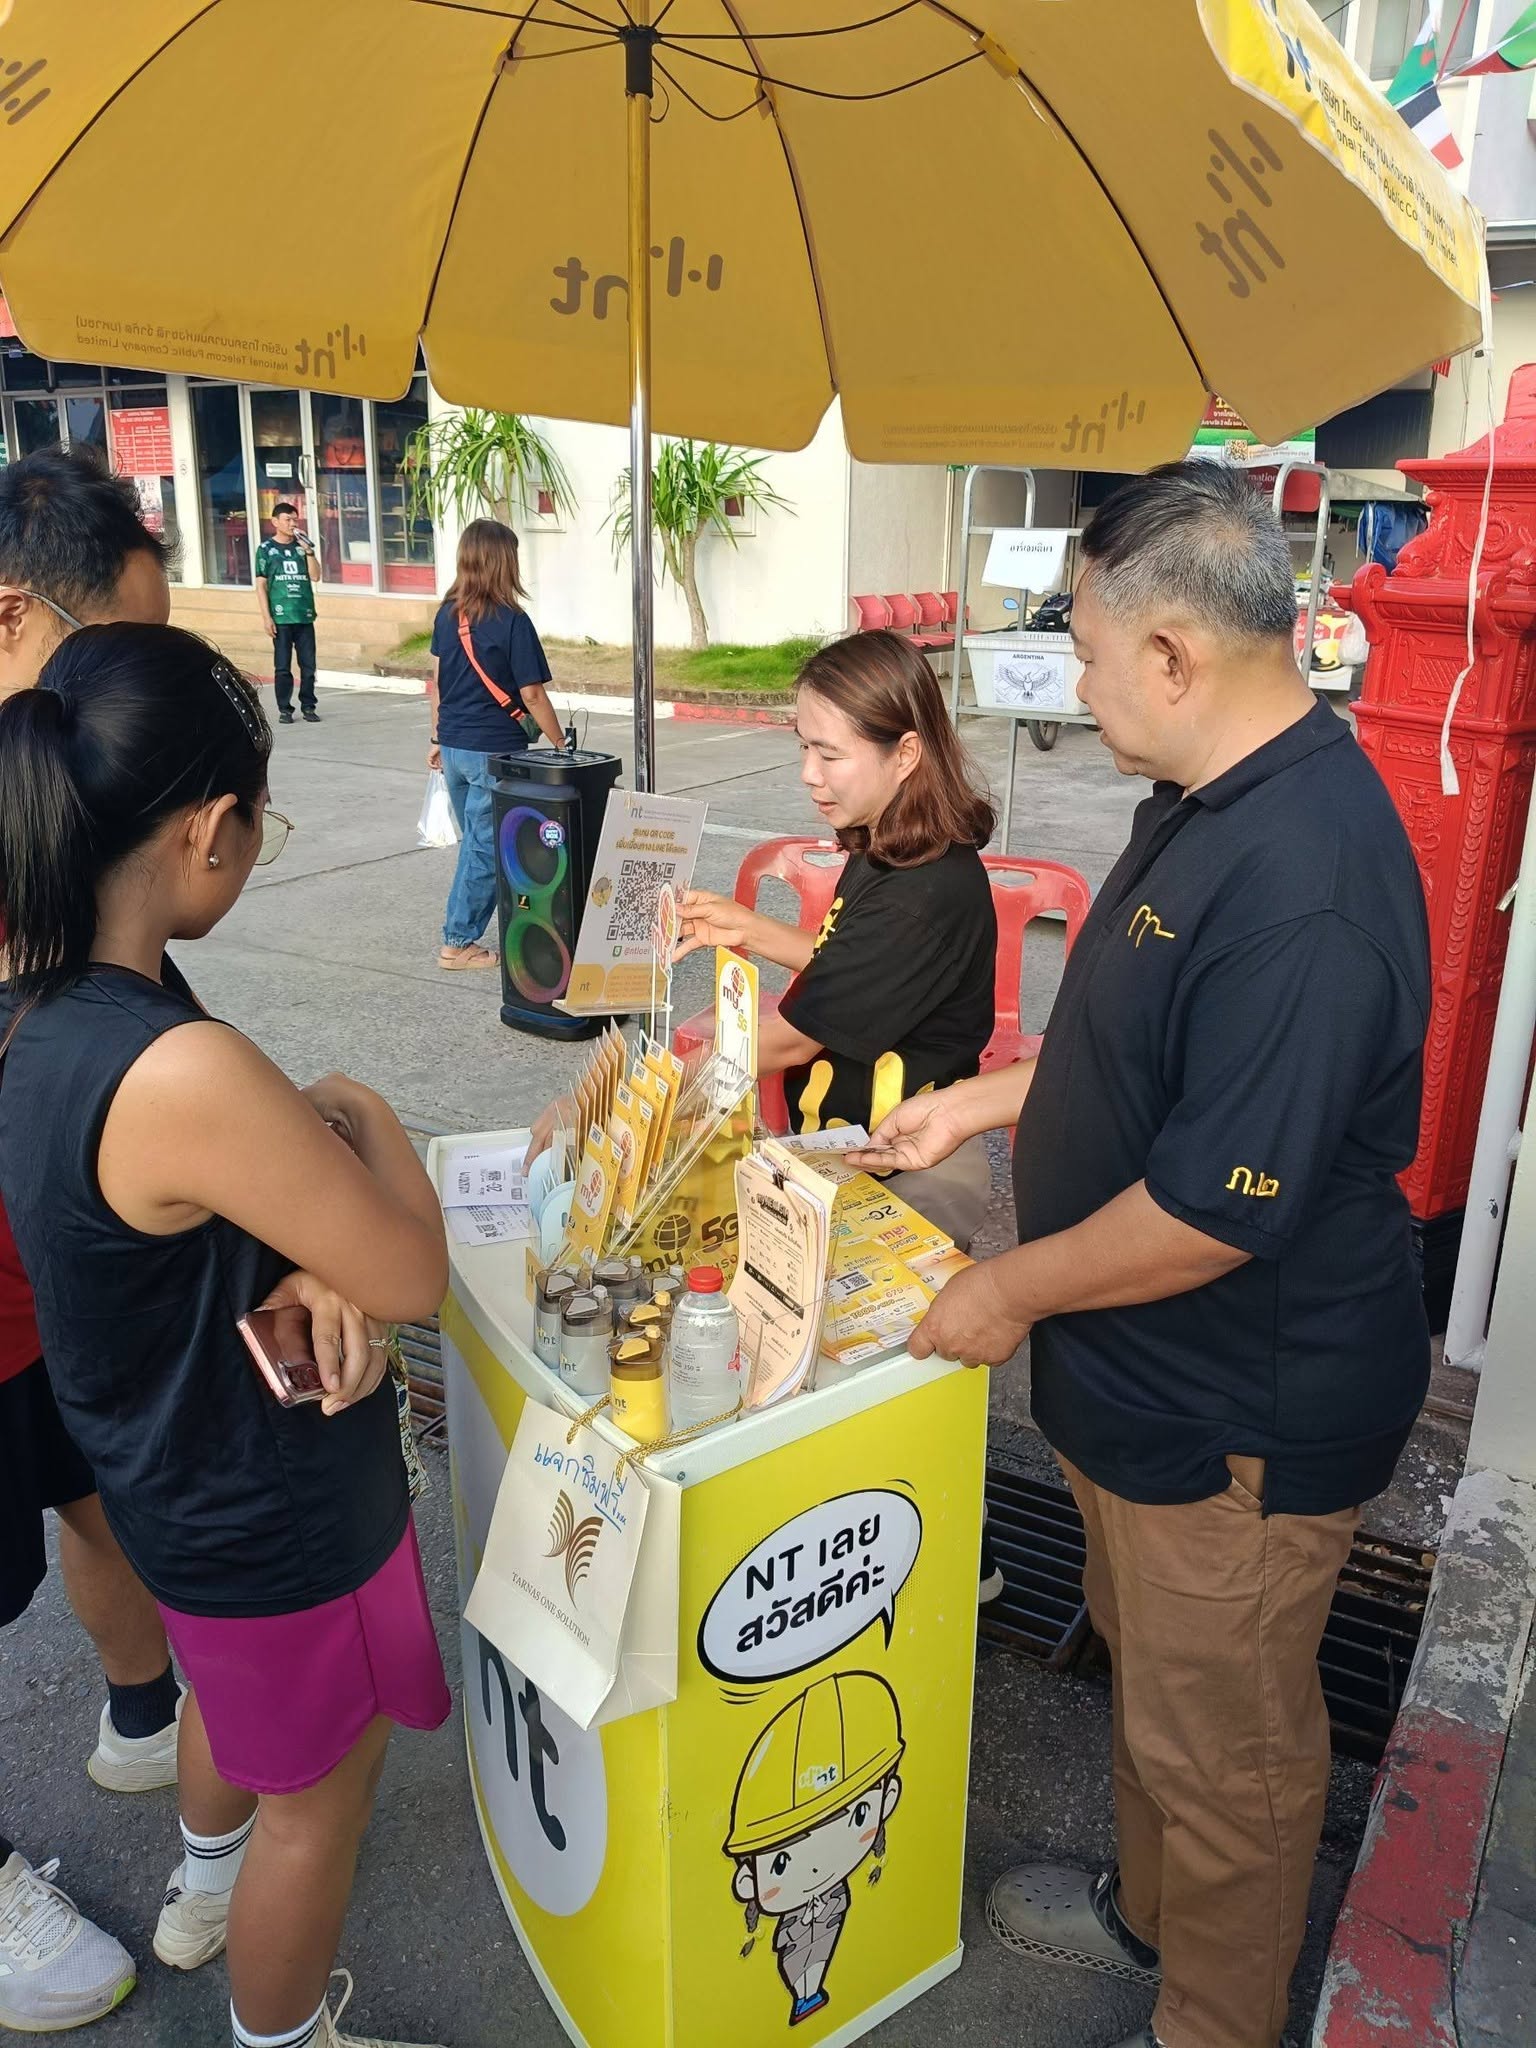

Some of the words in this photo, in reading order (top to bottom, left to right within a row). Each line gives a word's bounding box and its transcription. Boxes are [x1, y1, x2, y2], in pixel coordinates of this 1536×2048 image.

[1012, 653, 1045, 661] ARGENTINA
[659, 831, 675, 840] CODE
[579, 980, 592, 992] nt
[723, 985, 739, 1010] my
[543, 1333, 556, 1346] nt
[564, 1361, 577, 1372] nt
[614, 1396, 627, 1408] nt
[745, 1543, 804, 1600] NT
[818, 1513, 881, 1568] เลย
[511, 1571, 542, 1602] TARNAS
[540, 1595, 557, 1616] ONE
[556, 1607, 591, 1647] SOLUTION
[736, 1554, 886, 1653] สวัสดีค่ะ
